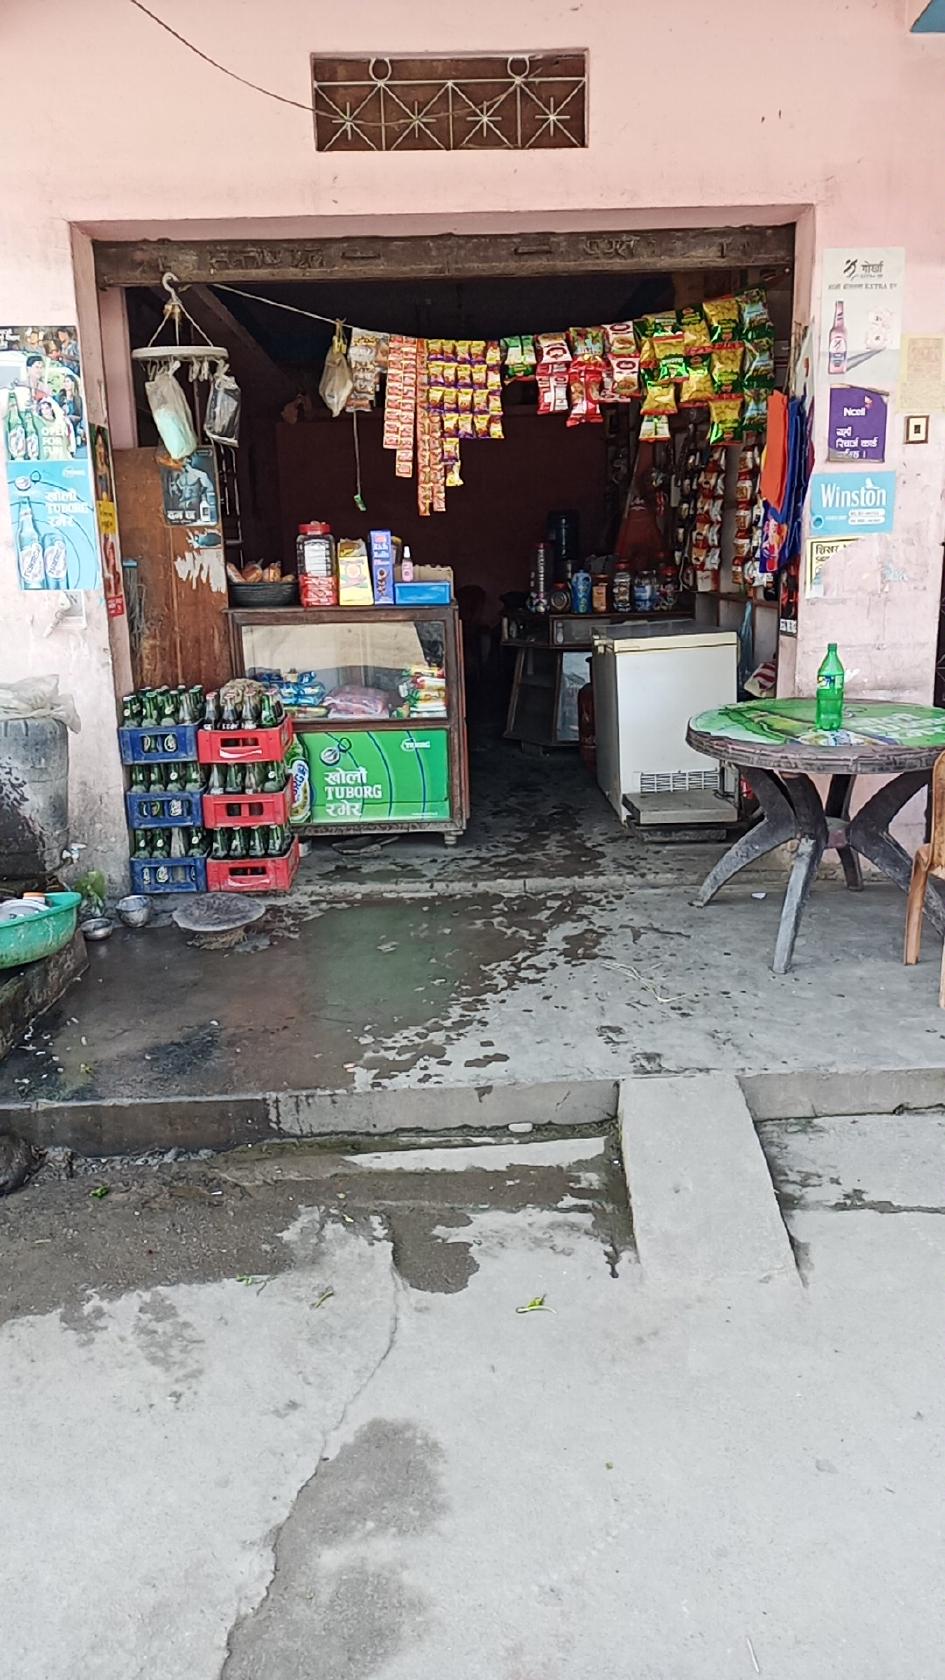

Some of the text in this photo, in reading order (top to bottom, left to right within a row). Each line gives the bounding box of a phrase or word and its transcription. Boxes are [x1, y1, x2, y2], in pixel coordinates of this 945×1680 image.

[843, 407, 866, 417] Ncell
[821, 483, 887, 508] Winston
[325, 784, 382, 800] TUBORG
